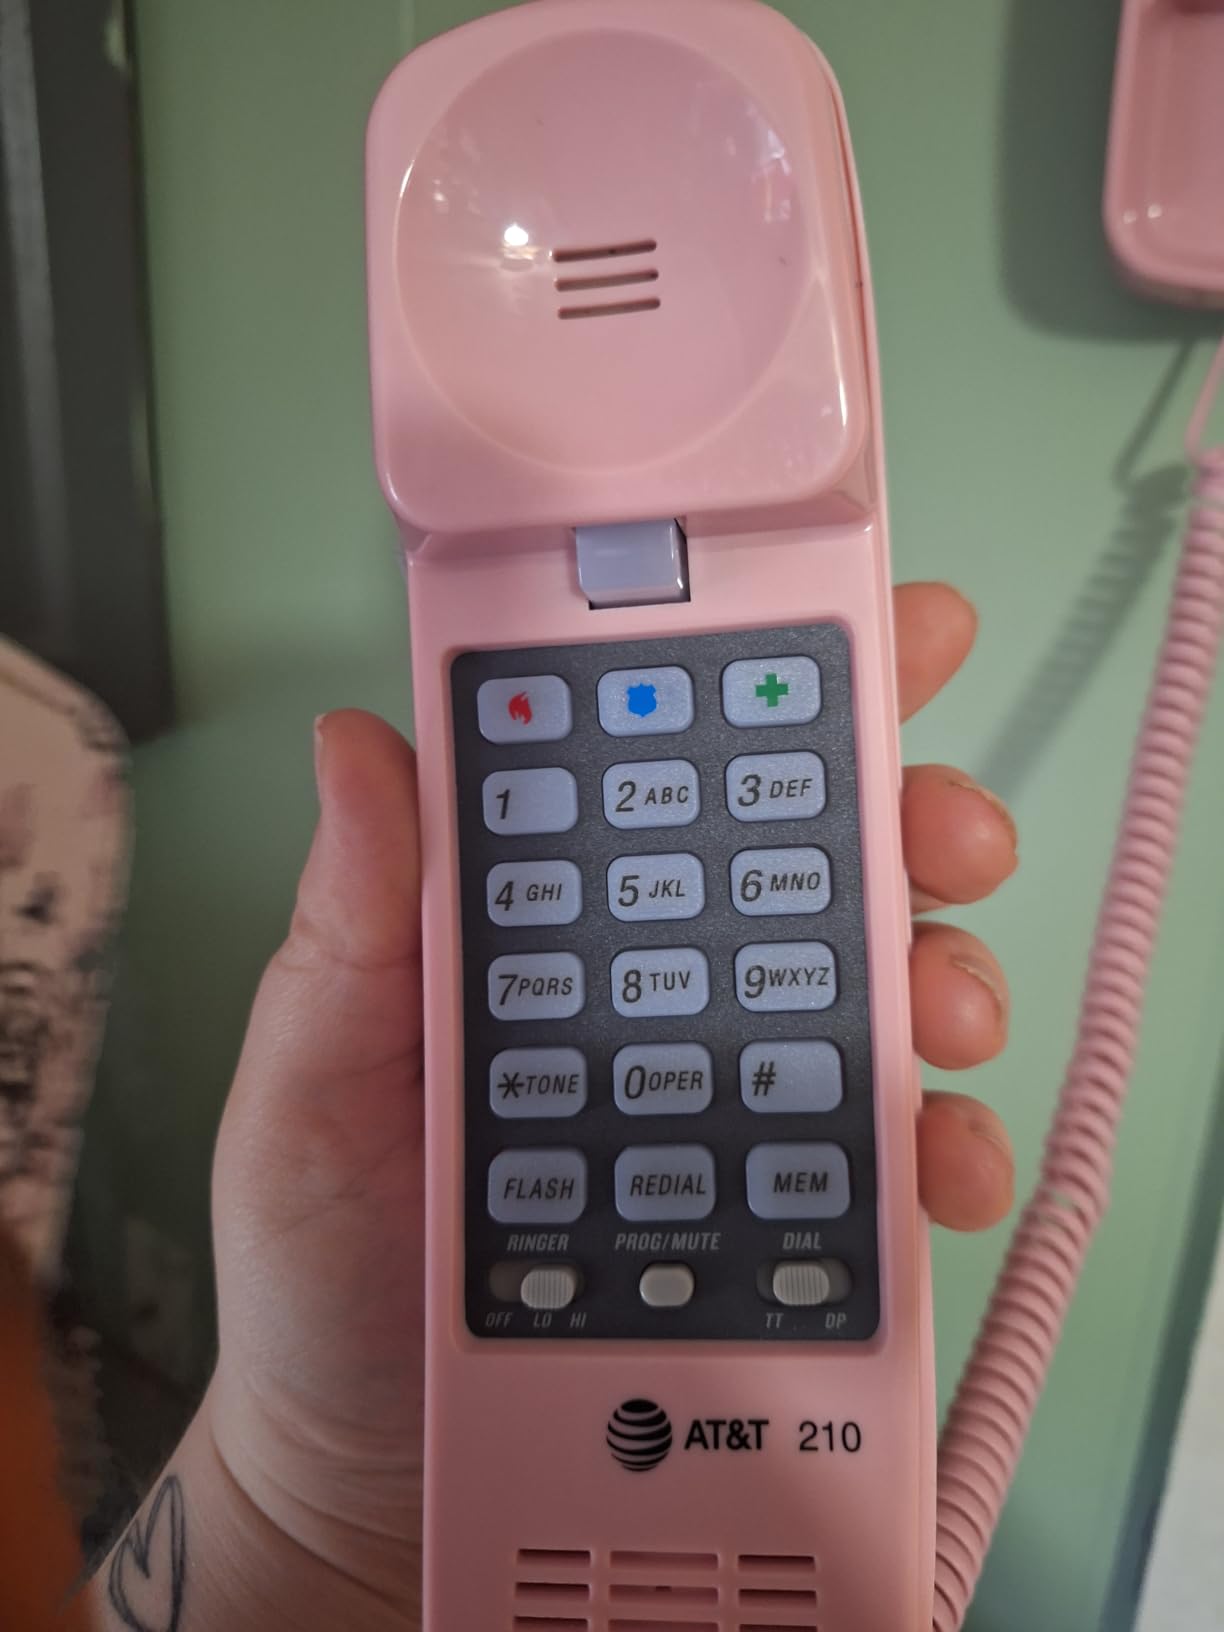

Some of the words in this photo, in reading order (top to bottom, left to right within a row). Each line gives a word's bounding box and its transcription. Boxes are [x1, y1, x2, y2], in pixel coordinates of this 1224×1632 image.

[614, 780, 637, 813] 2
[644, 785, 690, 805] ABC
[737, 773, 761, 807] 3
[769, 777, 813, 799] DEF
[495, 788, 511, 821] 1
[494, 880, 515, 912] 4
[526, 883, 563, 902] GHI
[617, 874, 640, 907] 5
[648, 878, 686, 900] JKL
[739, 868, 763, 902] 6
[769, 871, 821, 893] MNO
[622, 969, 643, 1004] 8
[649, 970, 691, 993] TUV
[751, 1060, 777, 1097] #
[503, 1177, 575, 1200] FLASH
[629, 1173, 706, 1197] REDIAL
[773, 1171, 829, 1193] MEM
[507, 1233, 570, 1252] RINGER
[614, 1232, 721, 1252] PROG/MUTE
[782, 1231, 822, 1250] DIAL
[484, 1311, 514, 1328] OFF
[533, 1311, 552, 1328] LO
[569, 1312, 588, 1328] HI
[765, 1311, 785, 1329] TT
[824, 1311, 847, 1329] DP
[684, 1418, 768, 1452] AT&T
[798, 1420, 863, 1453] 210
